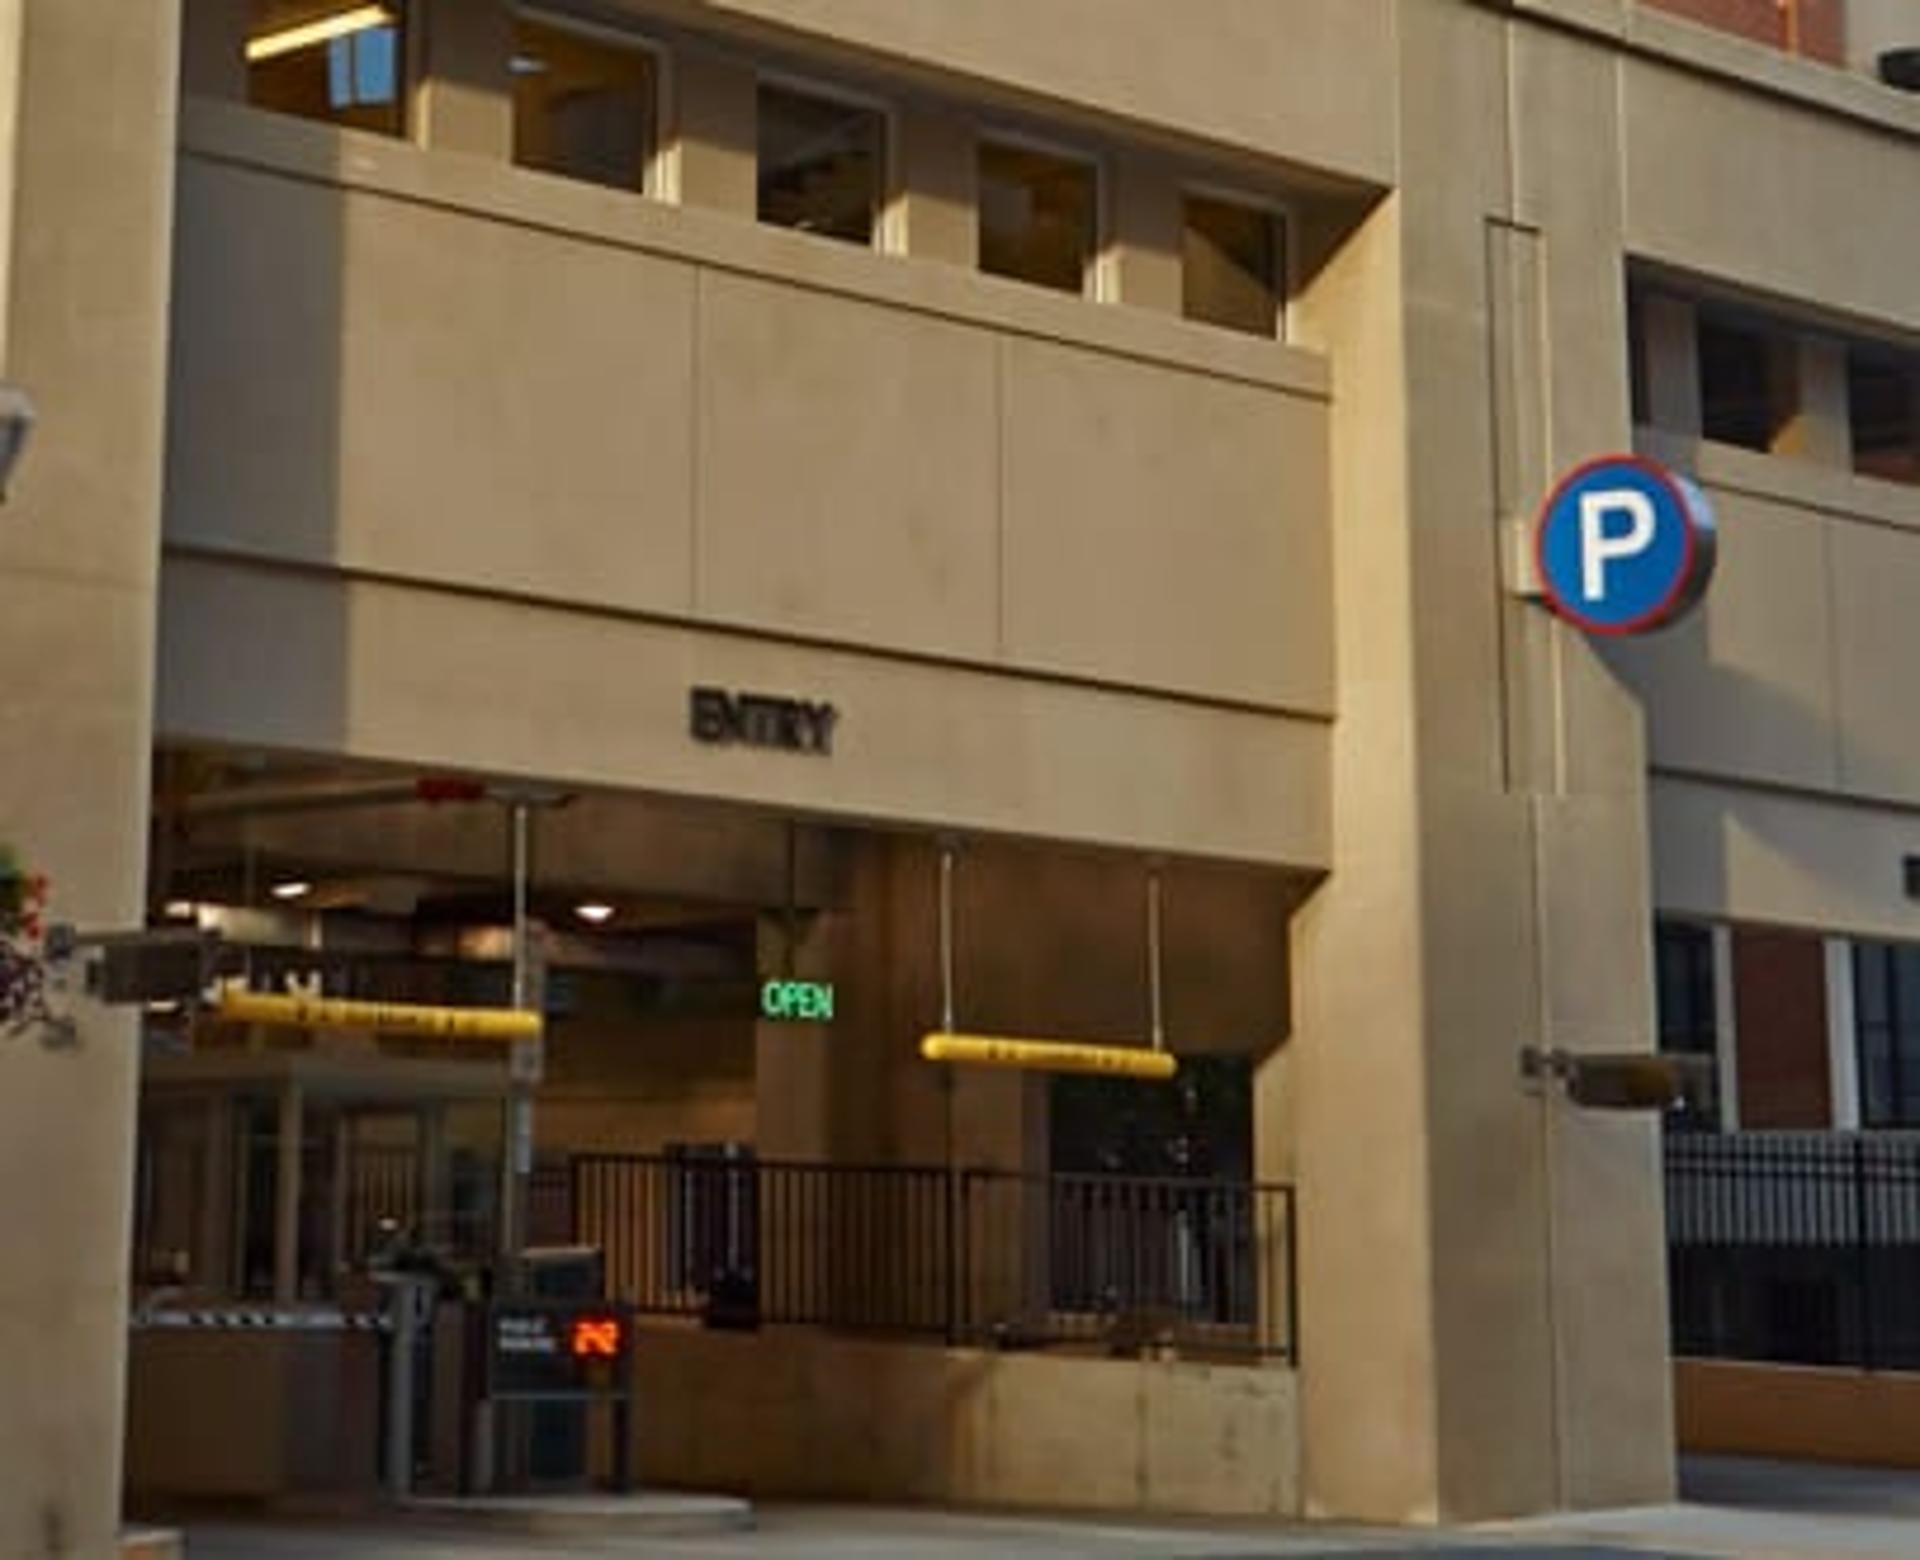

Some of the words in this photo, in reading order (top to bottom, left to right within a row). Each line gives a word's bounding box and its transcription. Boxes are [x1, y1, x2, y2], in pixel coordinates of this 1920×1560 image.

[1579, 489, 1656, 601] P
[689, 686, 838, 756] ENTRY
[762, 981, 834, 1018] OPEN
